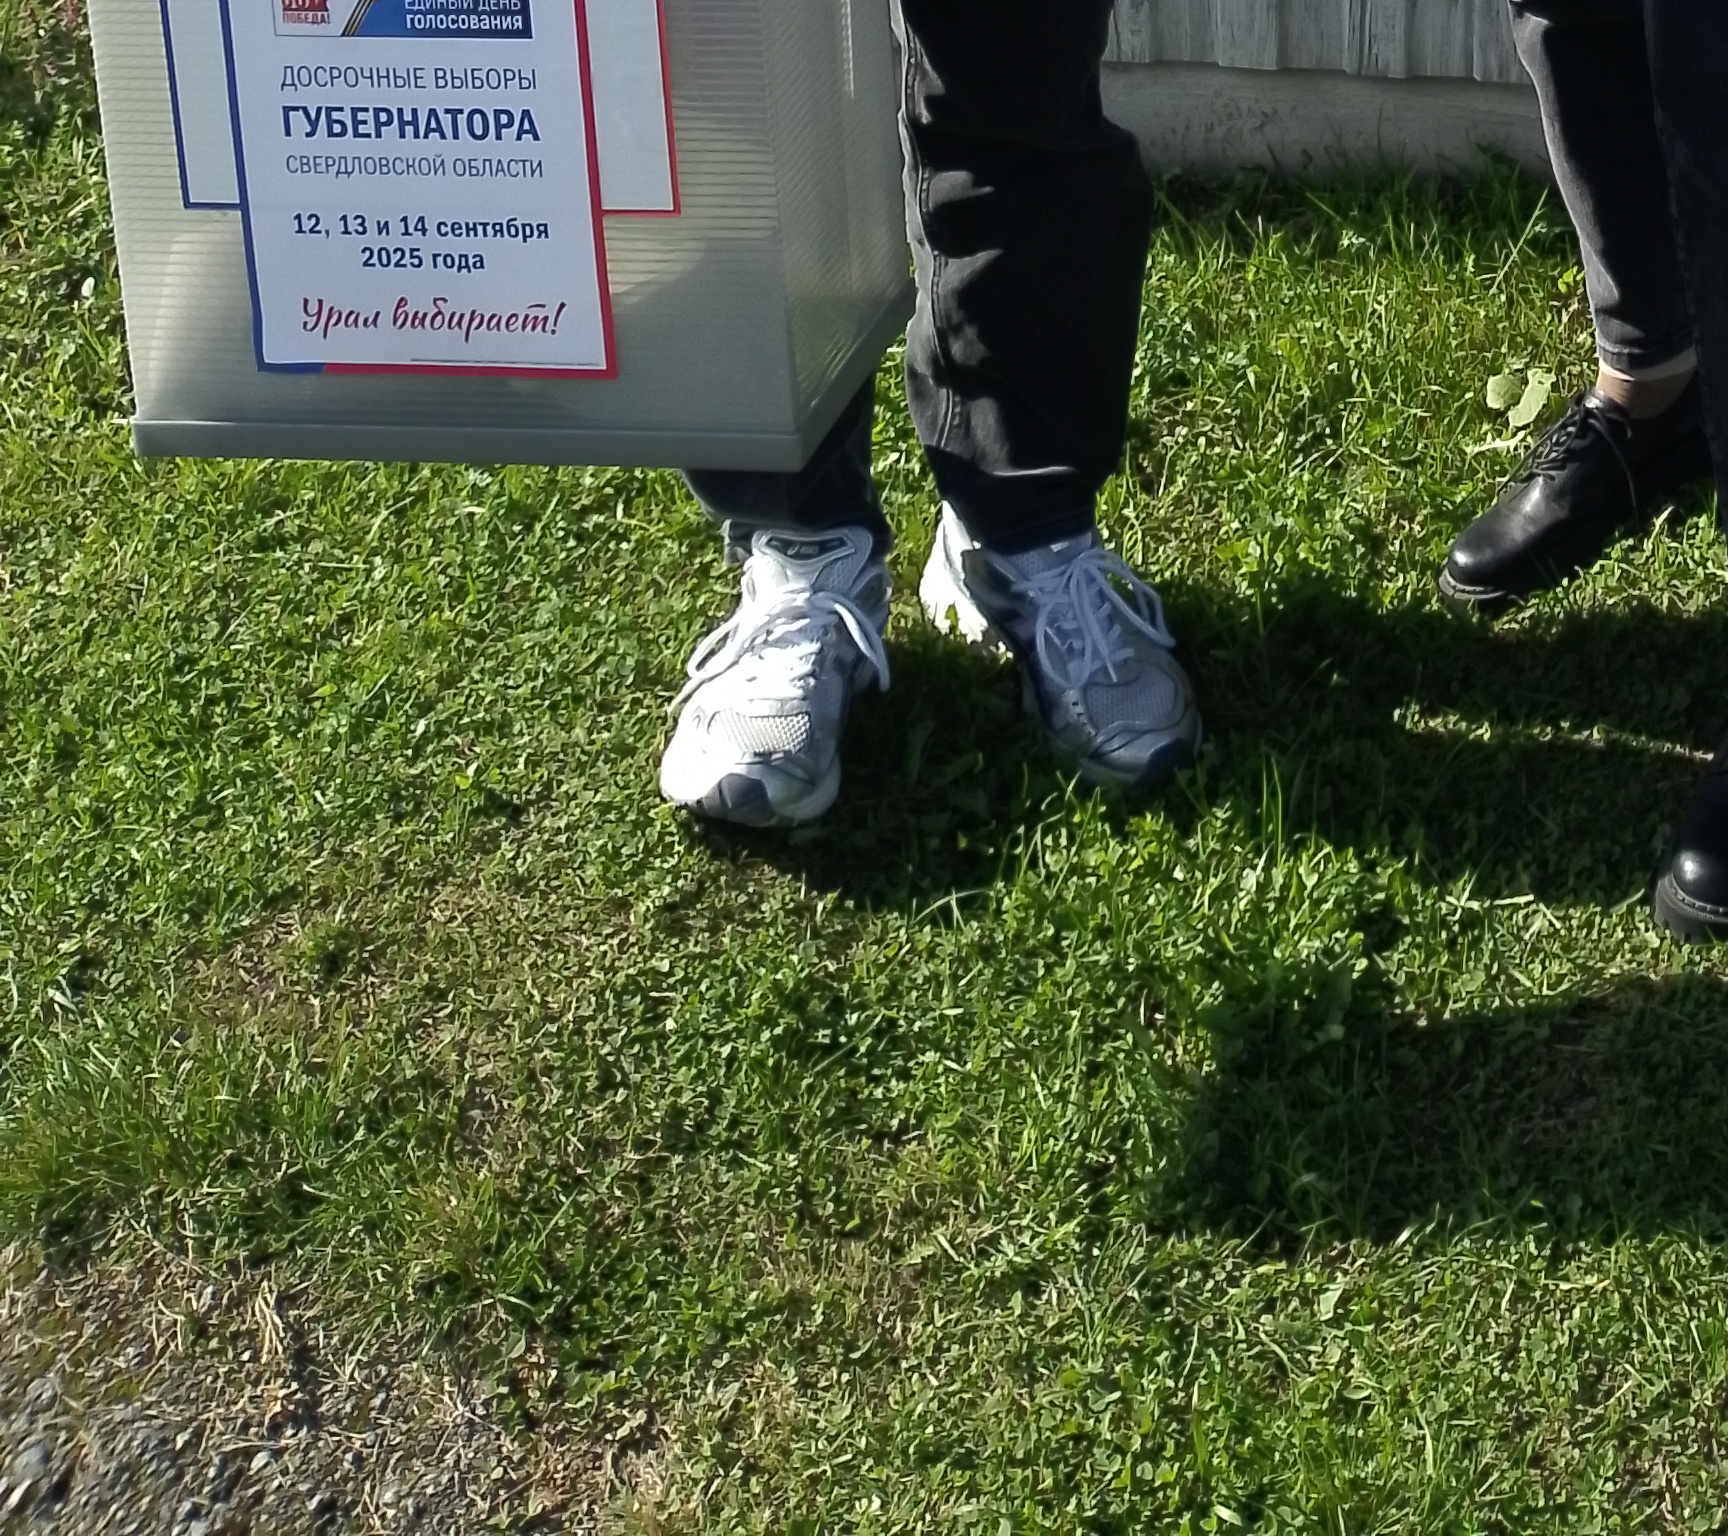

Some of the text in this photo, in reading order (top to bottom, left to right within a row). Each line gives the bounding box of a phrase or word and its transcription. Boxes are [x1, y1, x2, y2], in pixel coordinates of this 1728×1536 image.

[405, 14, 523, 30] голосования
[281, 65, 537, 92] ДОСРОЧНЫЕ ВЫБОРЫ
[281, 105, 541, 142] ГУБЕРНАТОРА
[286, 154, 544, 179] СВЕРДЛОВСКОЙ ОБЛАСТИ
[293, 213, 550, 243] 12, 13 и 14 сентября
[360, 247, 486, 273] 2025 года
[302, 296, 567, 344] Урал выбирает!
